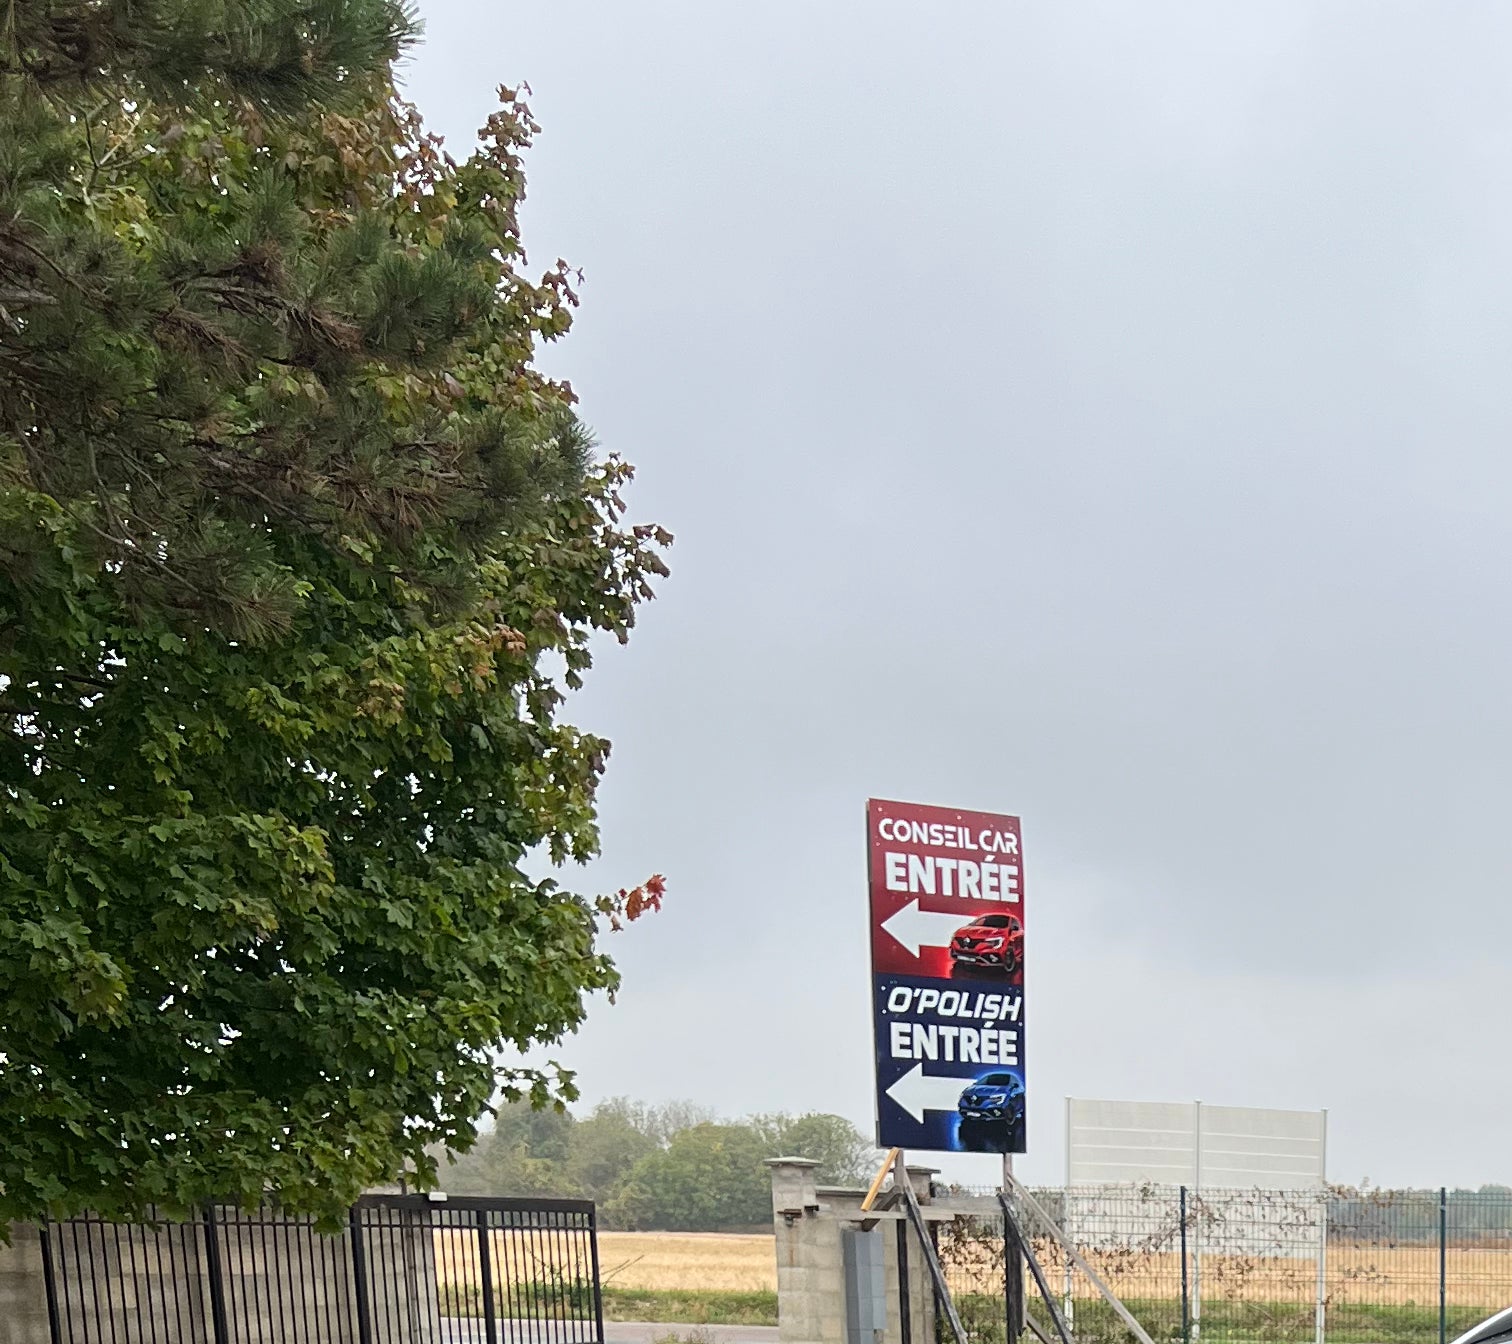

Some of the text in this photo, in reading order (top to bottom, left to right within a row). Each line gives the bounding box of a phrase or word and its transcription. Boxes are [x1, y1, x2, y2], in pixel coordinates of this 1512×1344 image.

[878, 818, 1019, 854] CONSEIL CAR
[885, 852, 1020, 903] ENTRÉE
[888, 986, 1022, 1021] O'POLISH
[890, 1021, 1018, 1065] ENTRÉE
